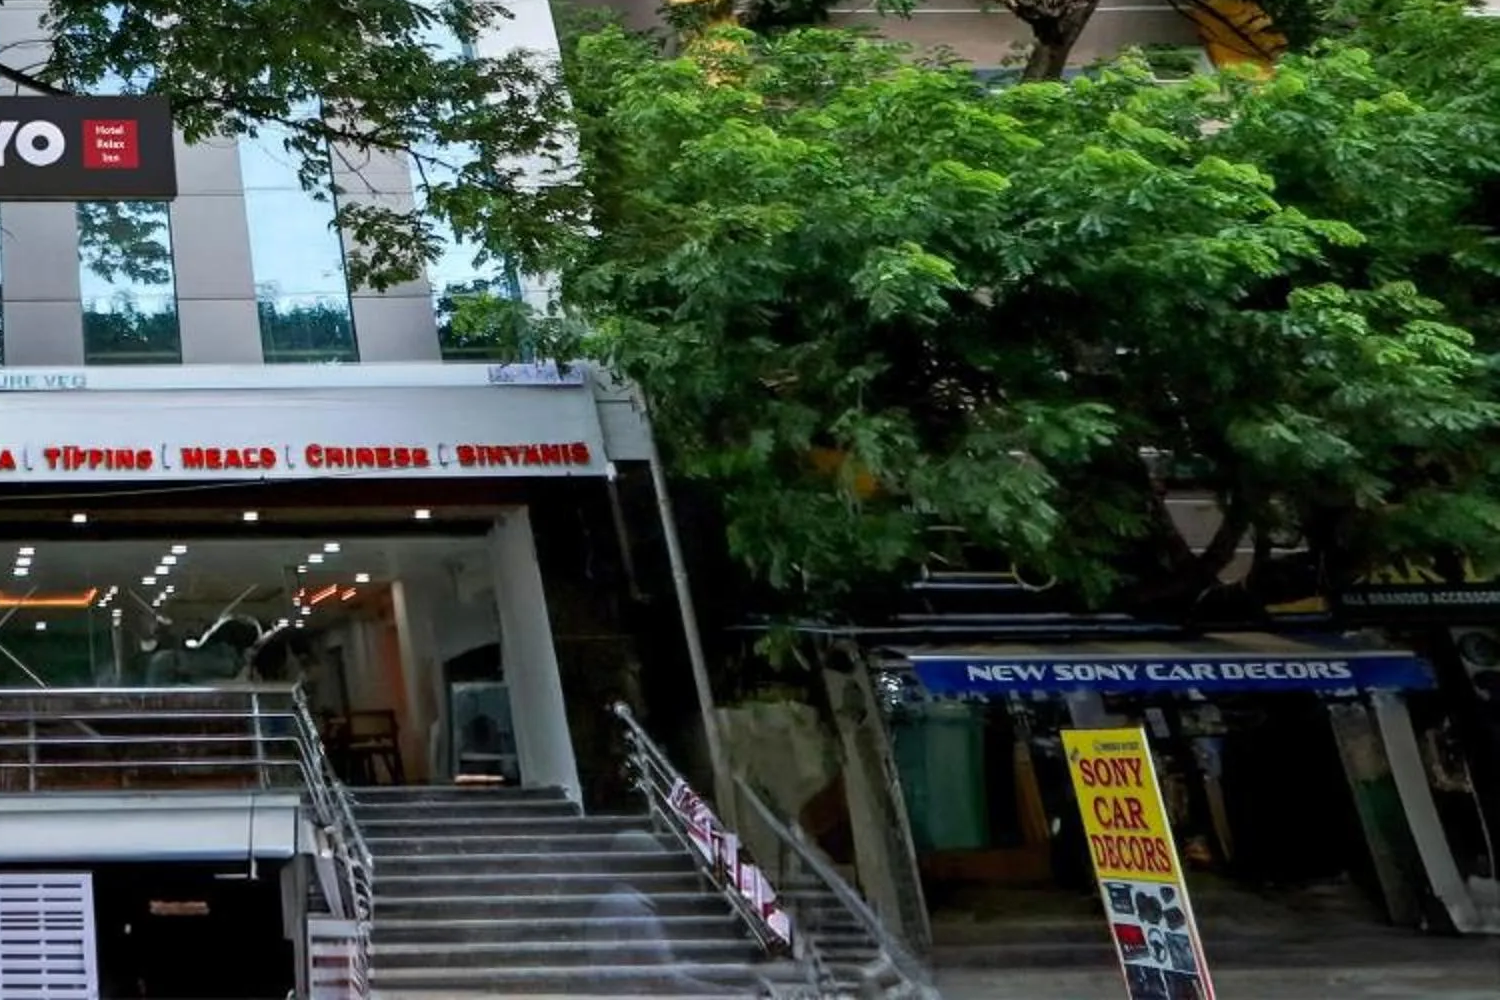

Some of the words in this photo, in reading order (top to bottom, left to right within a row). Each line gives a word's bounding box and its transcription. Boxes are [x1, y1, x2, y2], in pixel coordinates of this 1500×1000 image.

[94, 124, 124, 135] Hotel
[96, 138, 125, 149] Relax
[180, 446, 277, 470] MEALS
[967, 663, 1047, 682] NEW
[1052, 663, 1138, 681] SONY
[1145, 662, 1218, 681] CAR
[1219, 661, 1353, 680] DECORS
[1079, 757, 1143, 788] SONY
[1093, 796, 1150, 830] CAR
[1090, 834, 1172, 873] DECORS
